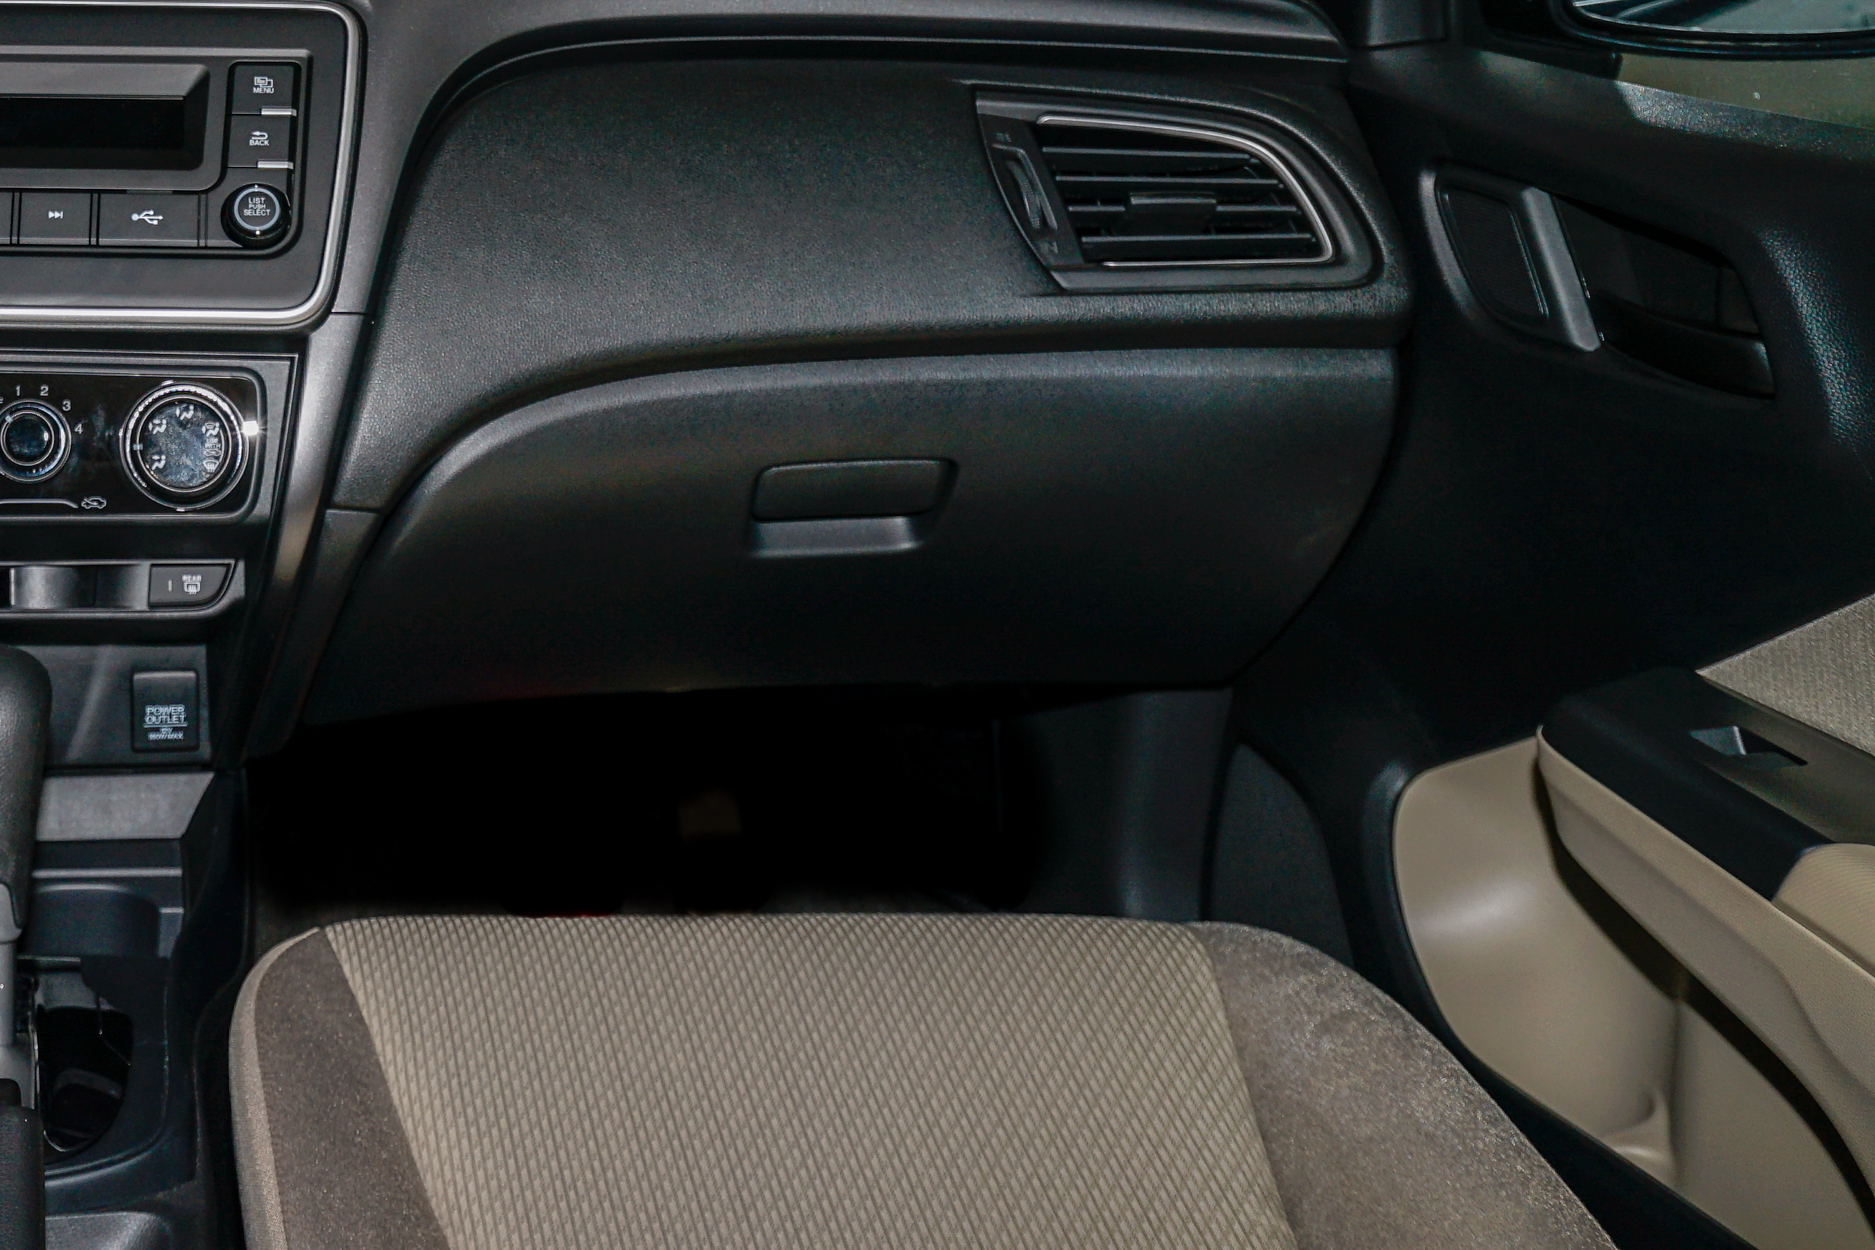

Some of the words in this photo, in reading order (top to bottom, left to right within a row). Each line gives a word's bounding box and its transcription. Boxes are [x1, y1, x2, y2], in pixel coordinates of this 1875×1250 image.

[252, 87, 275, 95] MENU
[249, 139, 270, 147] BACK
[243, 209, 271, 217] SELECT
[15, 385, 21, 396] 1
[40, 385, 49, 396] 2
[62, 400, 71, 412] 3
[74, 423, 84, 435] 4
[145, 704, 185, 715] POWER
[145, 714, 186, 724] OUTLET
